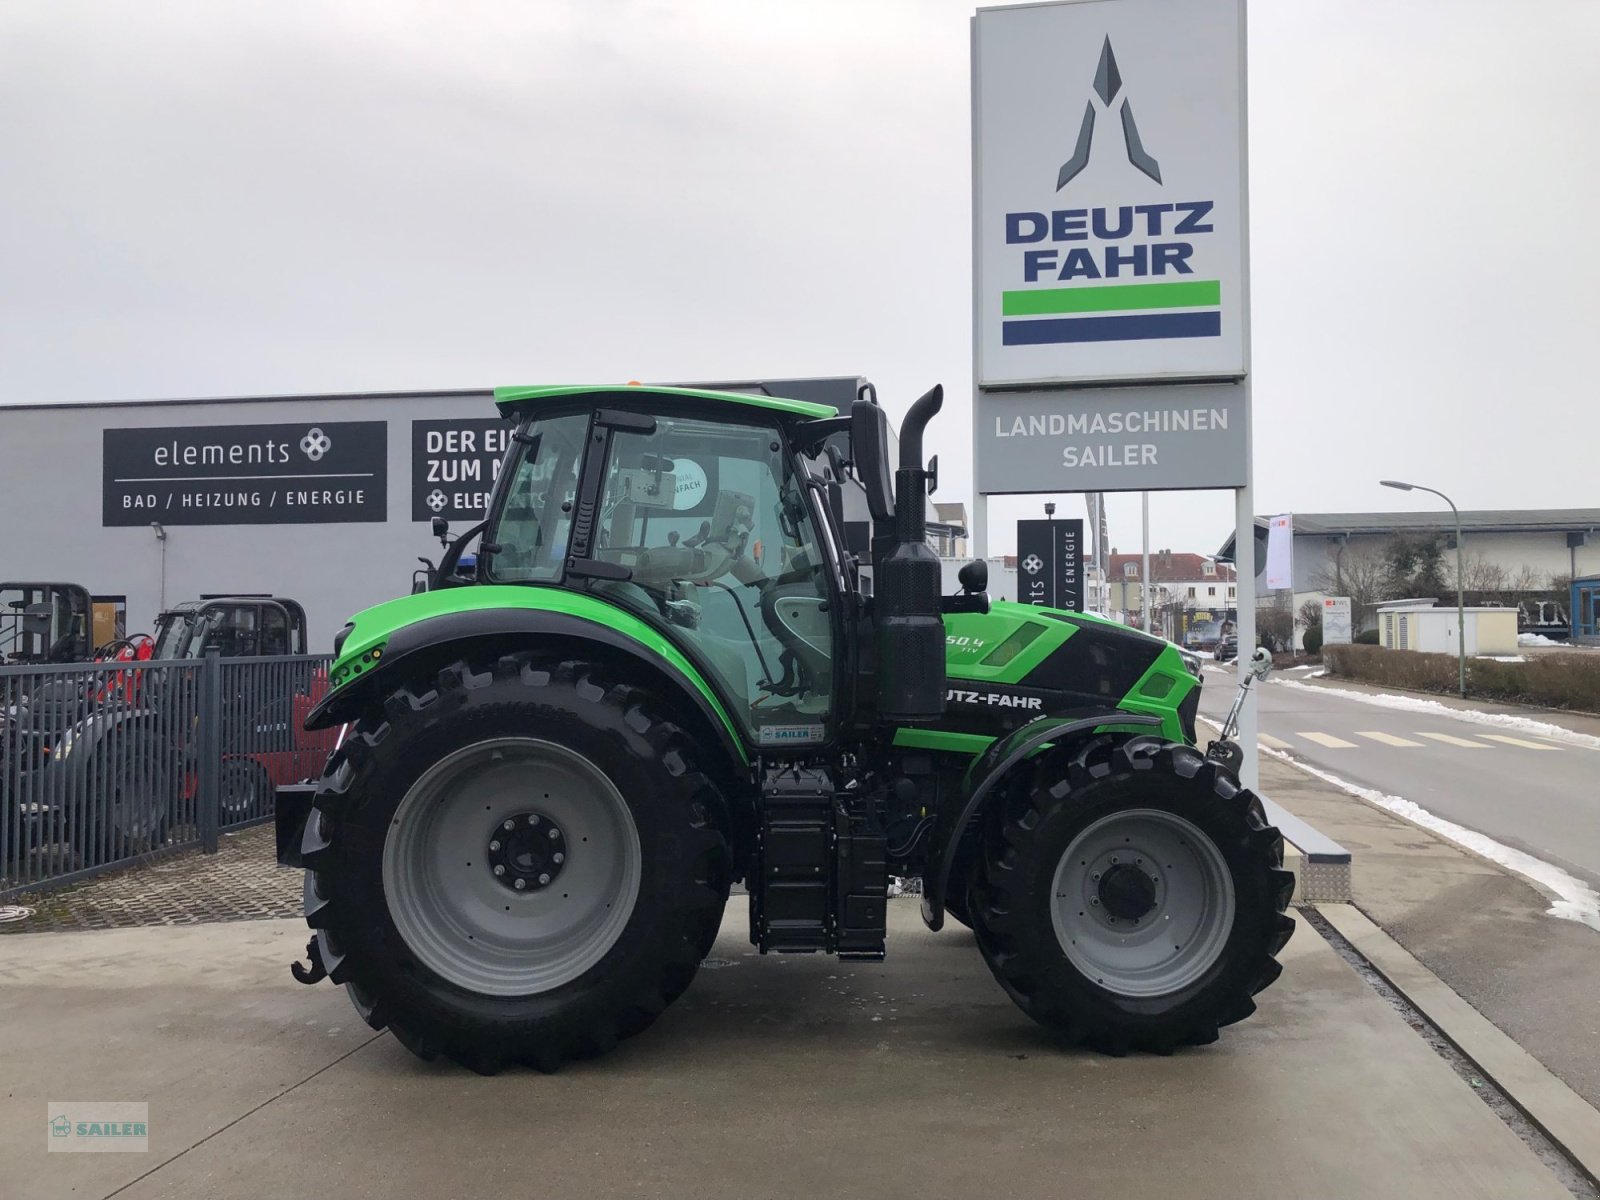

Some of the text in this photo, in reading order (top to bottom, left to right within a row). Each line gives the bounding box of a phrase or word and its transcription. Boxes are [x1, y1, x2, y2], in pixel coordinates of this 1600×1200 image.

[1005, 200, 1214, 245] DEUTZ
[1024, 242, 1194, 282] FAHR
[995, 409, 1228, 437] LANDMASCHINEN
[154, 440, 290, 466] elements
[427, 430, 476, 453] DER
[1063, 444, 1158, 467] SAILER
[427, 459, 481, 482] ZUM
[123, 490, 365, 509] BAD / HEIZUNG / ENERGIE
[1065, 531, 1075, 584] ENERGIE
[774, 730, 810, 738] SAILER
